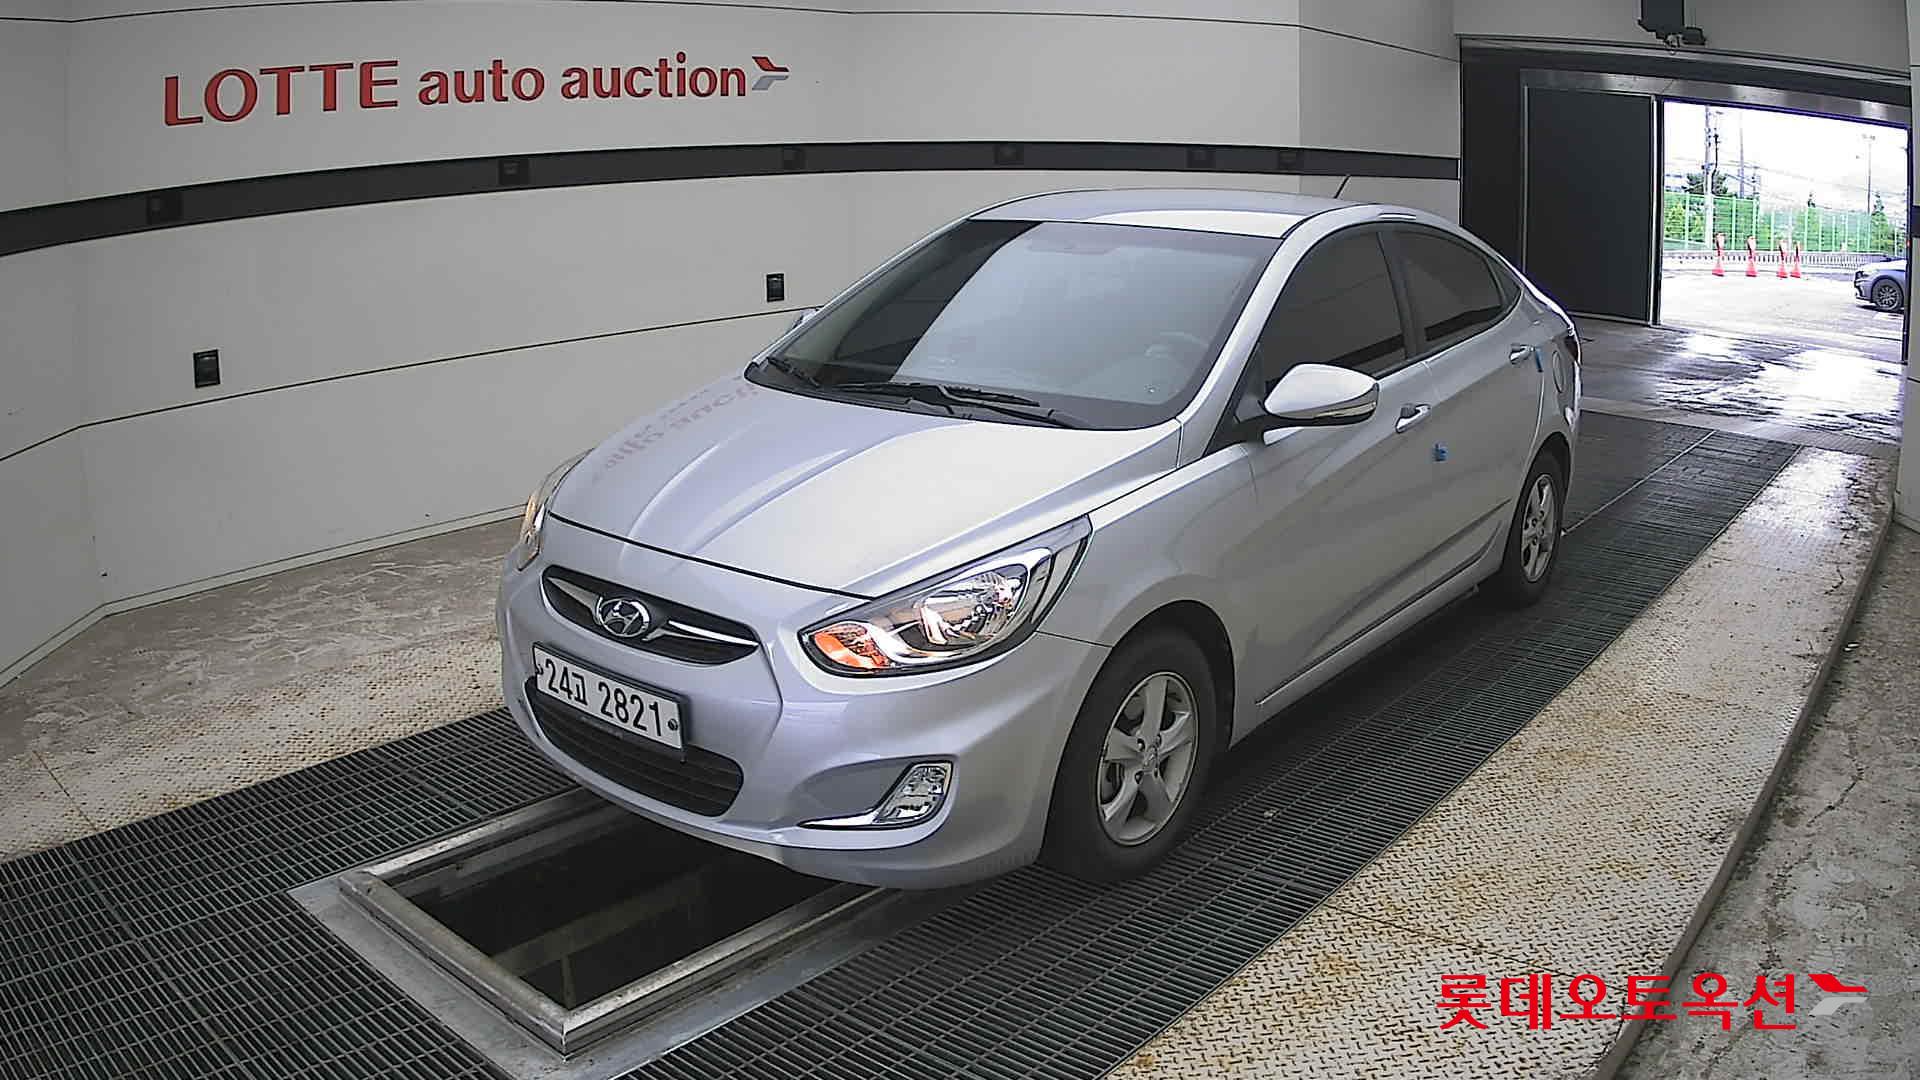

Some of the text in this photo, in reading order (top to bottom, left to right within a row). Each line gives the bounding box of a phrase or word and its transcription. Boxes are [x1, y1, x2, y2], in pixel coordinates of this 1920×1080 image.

[164, 51, 747, 126] LOTTE auto auction
[545, 658, 663, 737] 24고 2821
